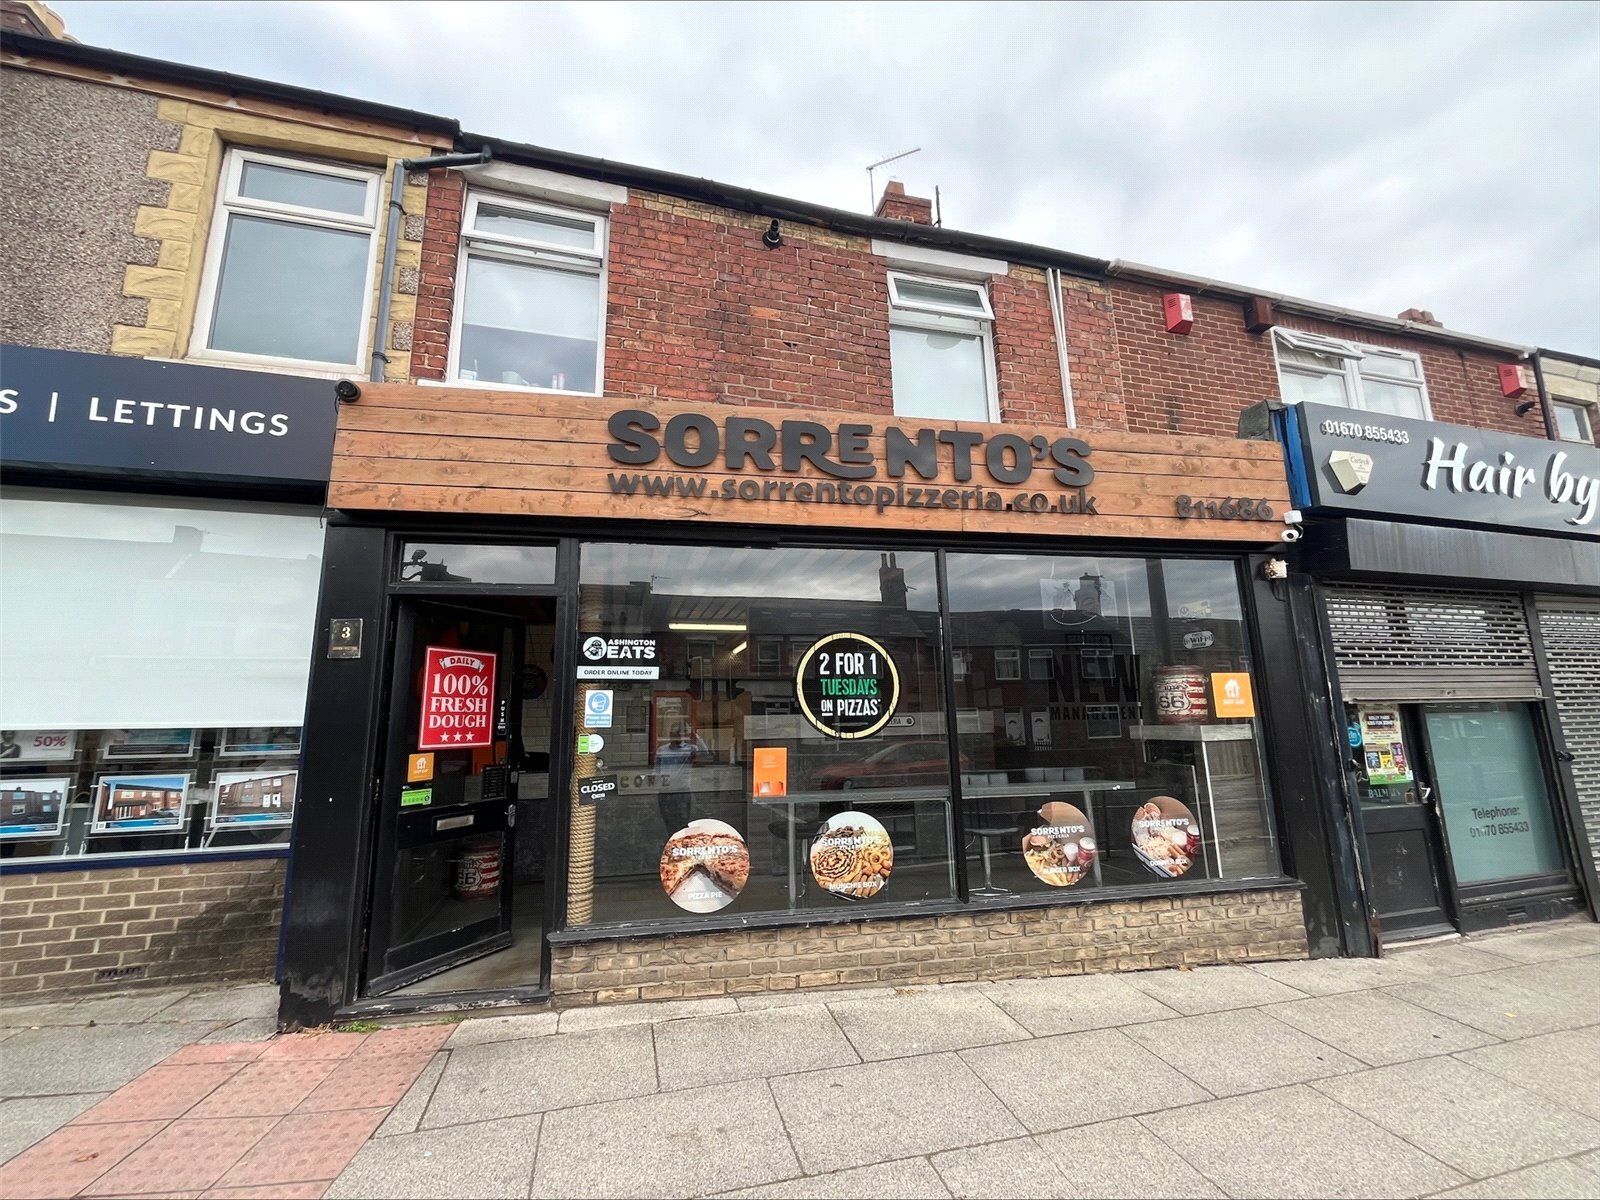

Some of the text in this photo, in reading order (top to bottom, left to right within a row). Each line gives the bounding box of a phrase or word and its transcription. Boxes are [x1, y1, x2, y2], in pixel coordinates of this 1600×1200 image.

[89, 397, 289, 437] LETTINGS
[1325, 419, 1410, 444] 01670 855433
[606, 409, 1095, 487] SORRENTO'S
[1426, 437, 1600, 525] Hair by
[606, 472, 1099, 516] www.sorrentopizzeria.co.uk
[1176, 494, 1274, 520] 811686
[341, 626, 352, 639] 3
[607, 638, 656, 646] ASHINGTON
[606, 646, 656, 660] EATS
[450, 657, 476, 666] DAILY
[819, 652, 877, 675] 2 FOR 1
[431, 673, 489, 696] 100%
[820, 678, 878, 696] TUESDAYS
[430, 697, 488, 713] FRESH
[821, 701, 834, 717] ON
[428, 714, 487, 729] DOUGH
[33, 735, 67, 747] 50%
[580, 782, 616, 794] CLOSED
[1471, 806, 1521, 820] Telephone:
[1030, 825, 1085, 836] SORRENTO'S
[1138, 818, 1190, 828] SORRENTO'S
[1497, 821, 1530, 835] 855433
[672, 845, 738, 856] SORRENTO'S
